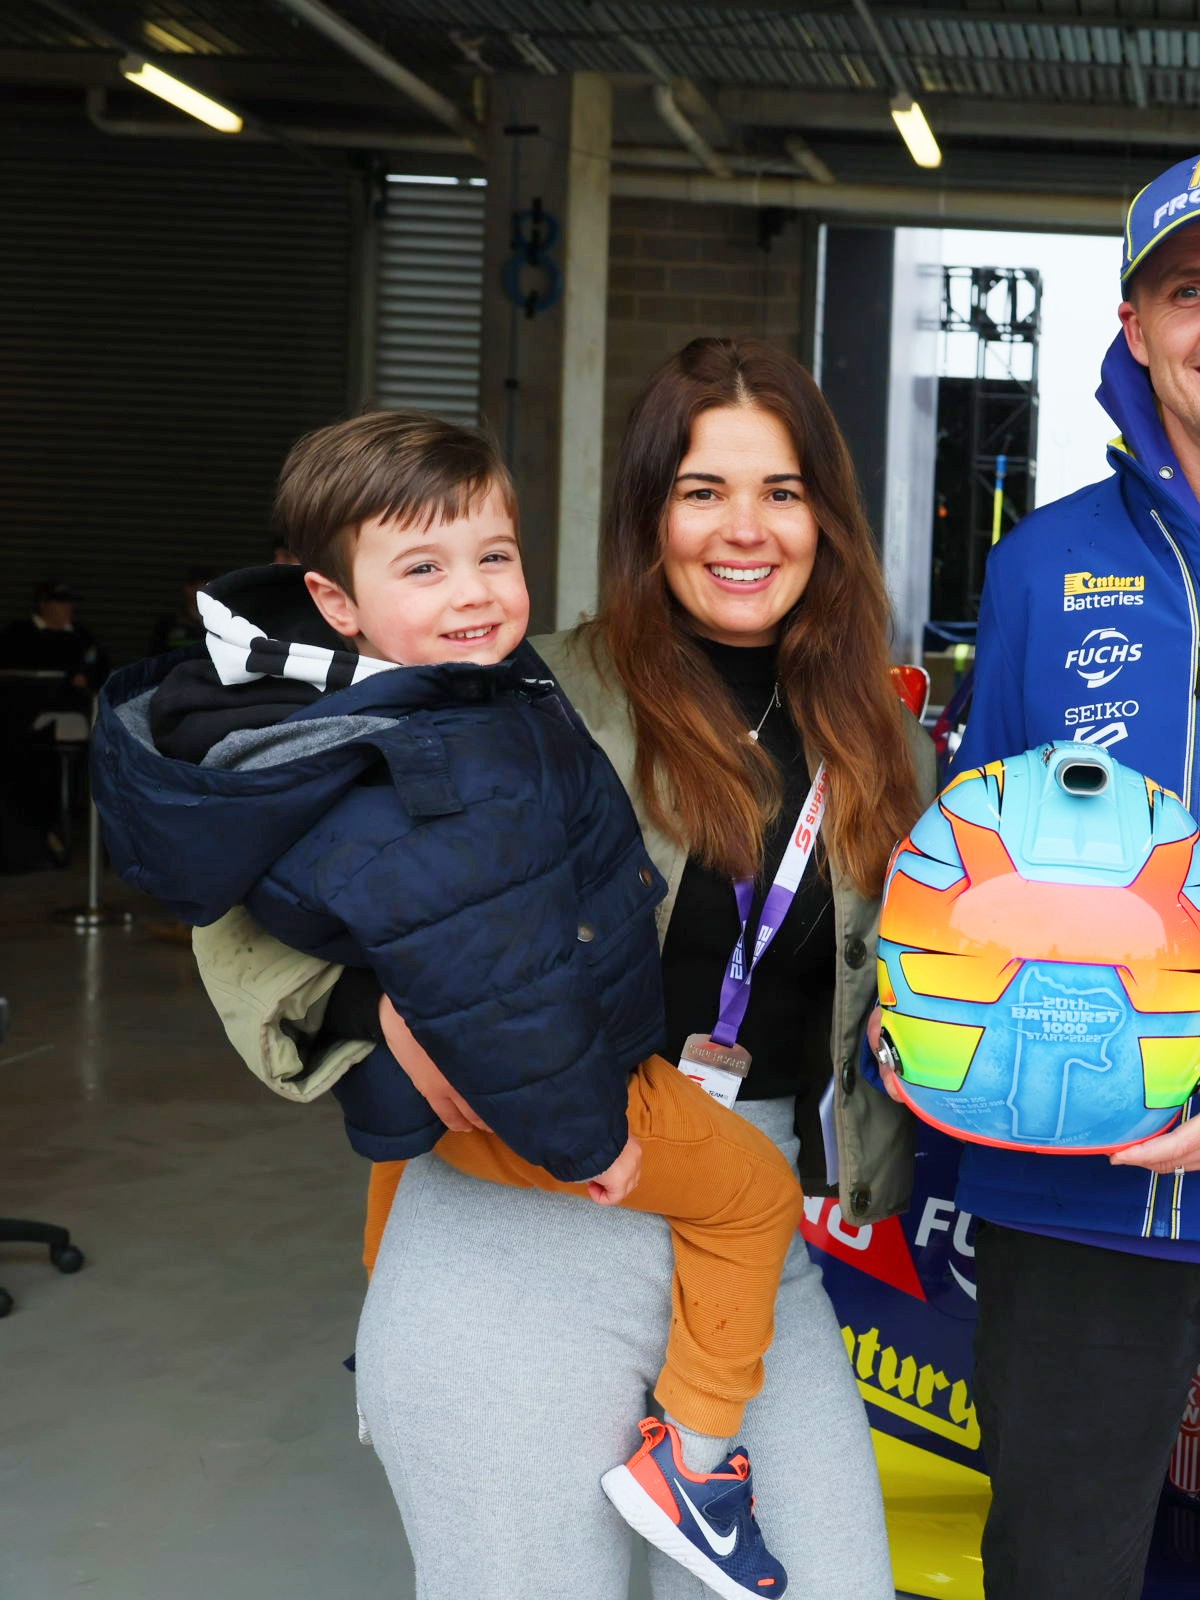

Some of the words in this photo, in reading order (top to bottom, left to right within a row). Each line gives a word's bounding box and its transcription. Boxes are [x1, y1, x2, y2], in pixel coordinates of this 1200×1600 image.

[1064, 571, 1145, 596] Century
[1064, 592, 1143, 611] Batteries
[1064, 643, 1143, 668] FUCHS
[1065, 700, 1139, 725] SEIKO
[1043, 996, 1090, 1010] 20th
[1011, 1007, 1119, 1023] BATHURST
[1042, 1022, 1088, 1034] 1000
[841, 1325, 981, 1449] tury
